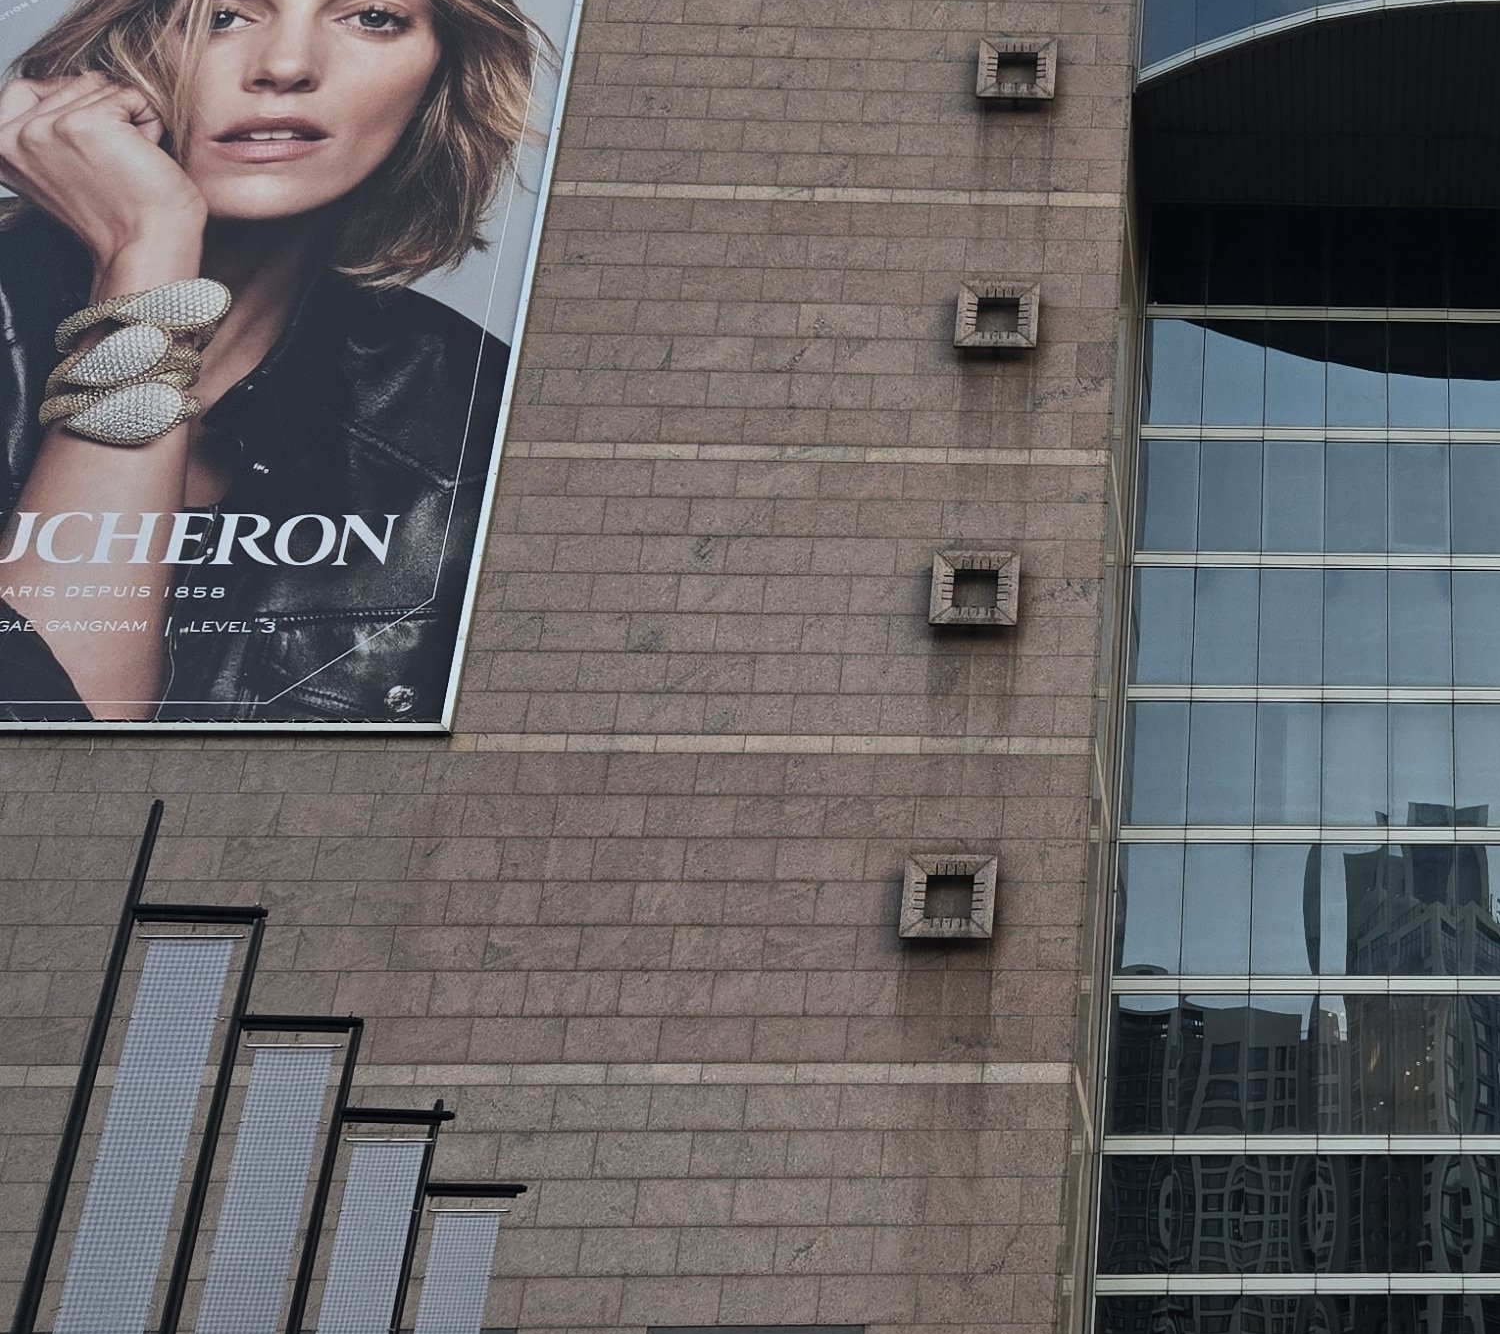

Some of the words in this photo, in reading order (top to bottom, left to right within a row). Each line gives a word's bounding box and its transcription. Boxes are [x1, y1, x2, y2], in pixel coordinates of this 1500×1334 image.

[0, 586, 56, 598] ARIS
[65, 586, 151, 598] DEPUIS
[164, 586, 226, 599] 1858
[46, 620, 148, 632] GANGNAM
[189, 621, 253, 633] LEVEL
[261, 621, 277, 634] 3
